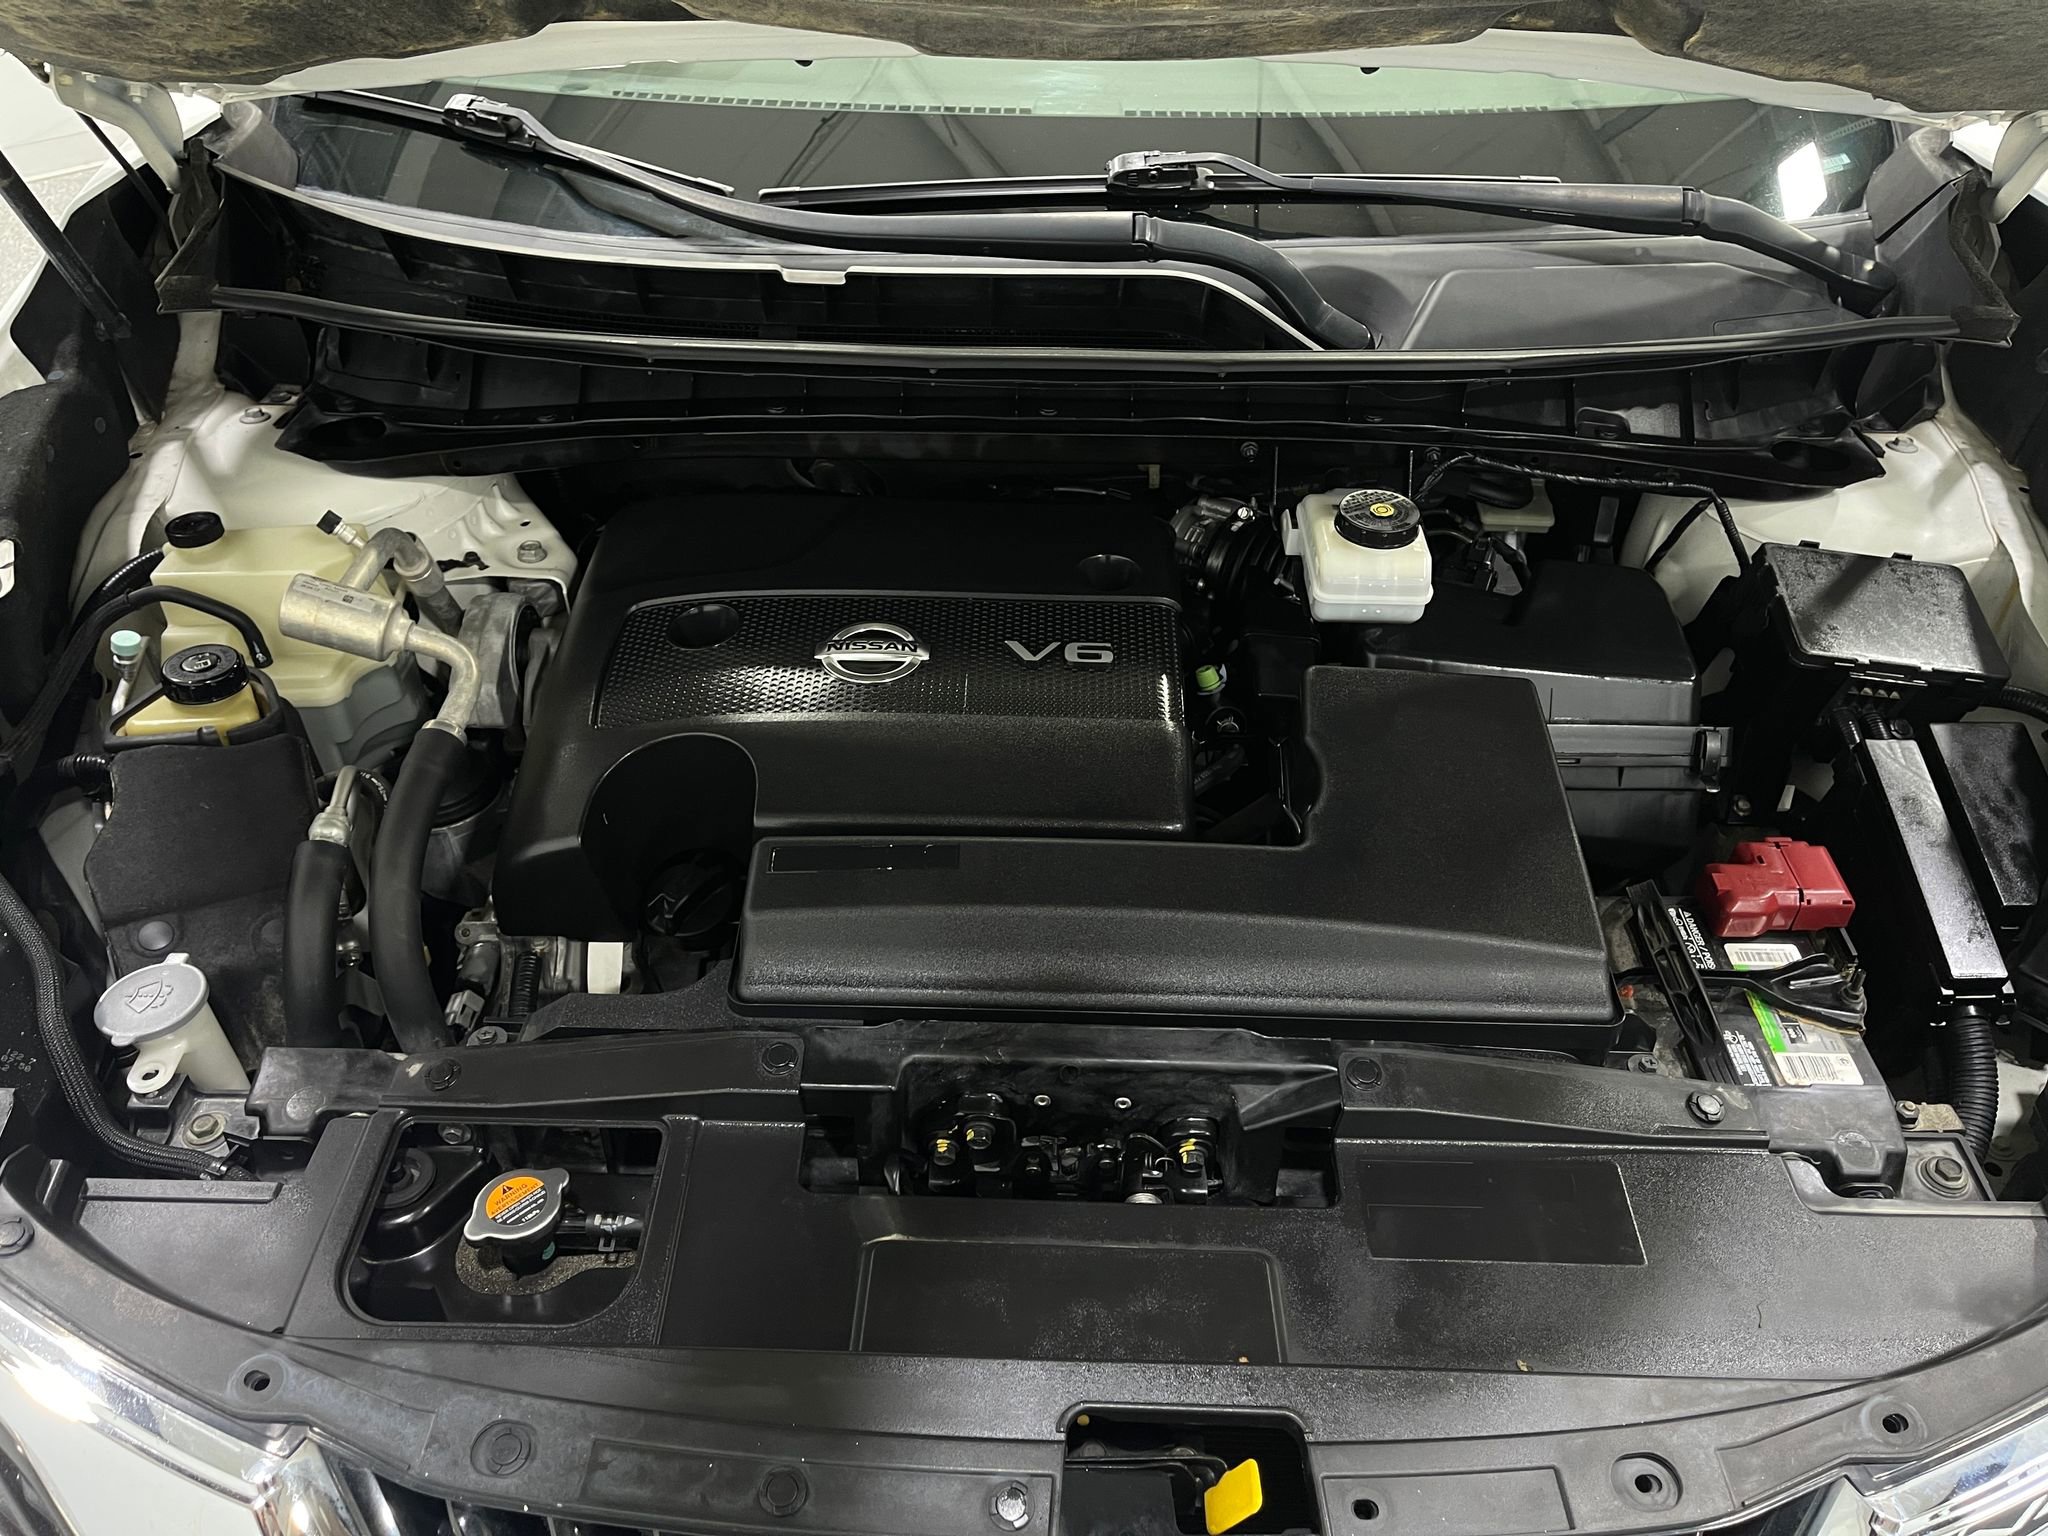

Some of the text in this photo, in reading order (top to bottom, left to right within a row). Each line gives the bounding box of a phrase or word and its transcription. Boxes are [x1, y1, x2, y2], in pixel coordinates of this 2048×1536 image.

[826, 640, 919, 653] NISSAN
[1004, 640, 1114, 663] V6
[1686, 918, 1705, 946] DANGER
[495, 1184, 528, 1205] WARNING
